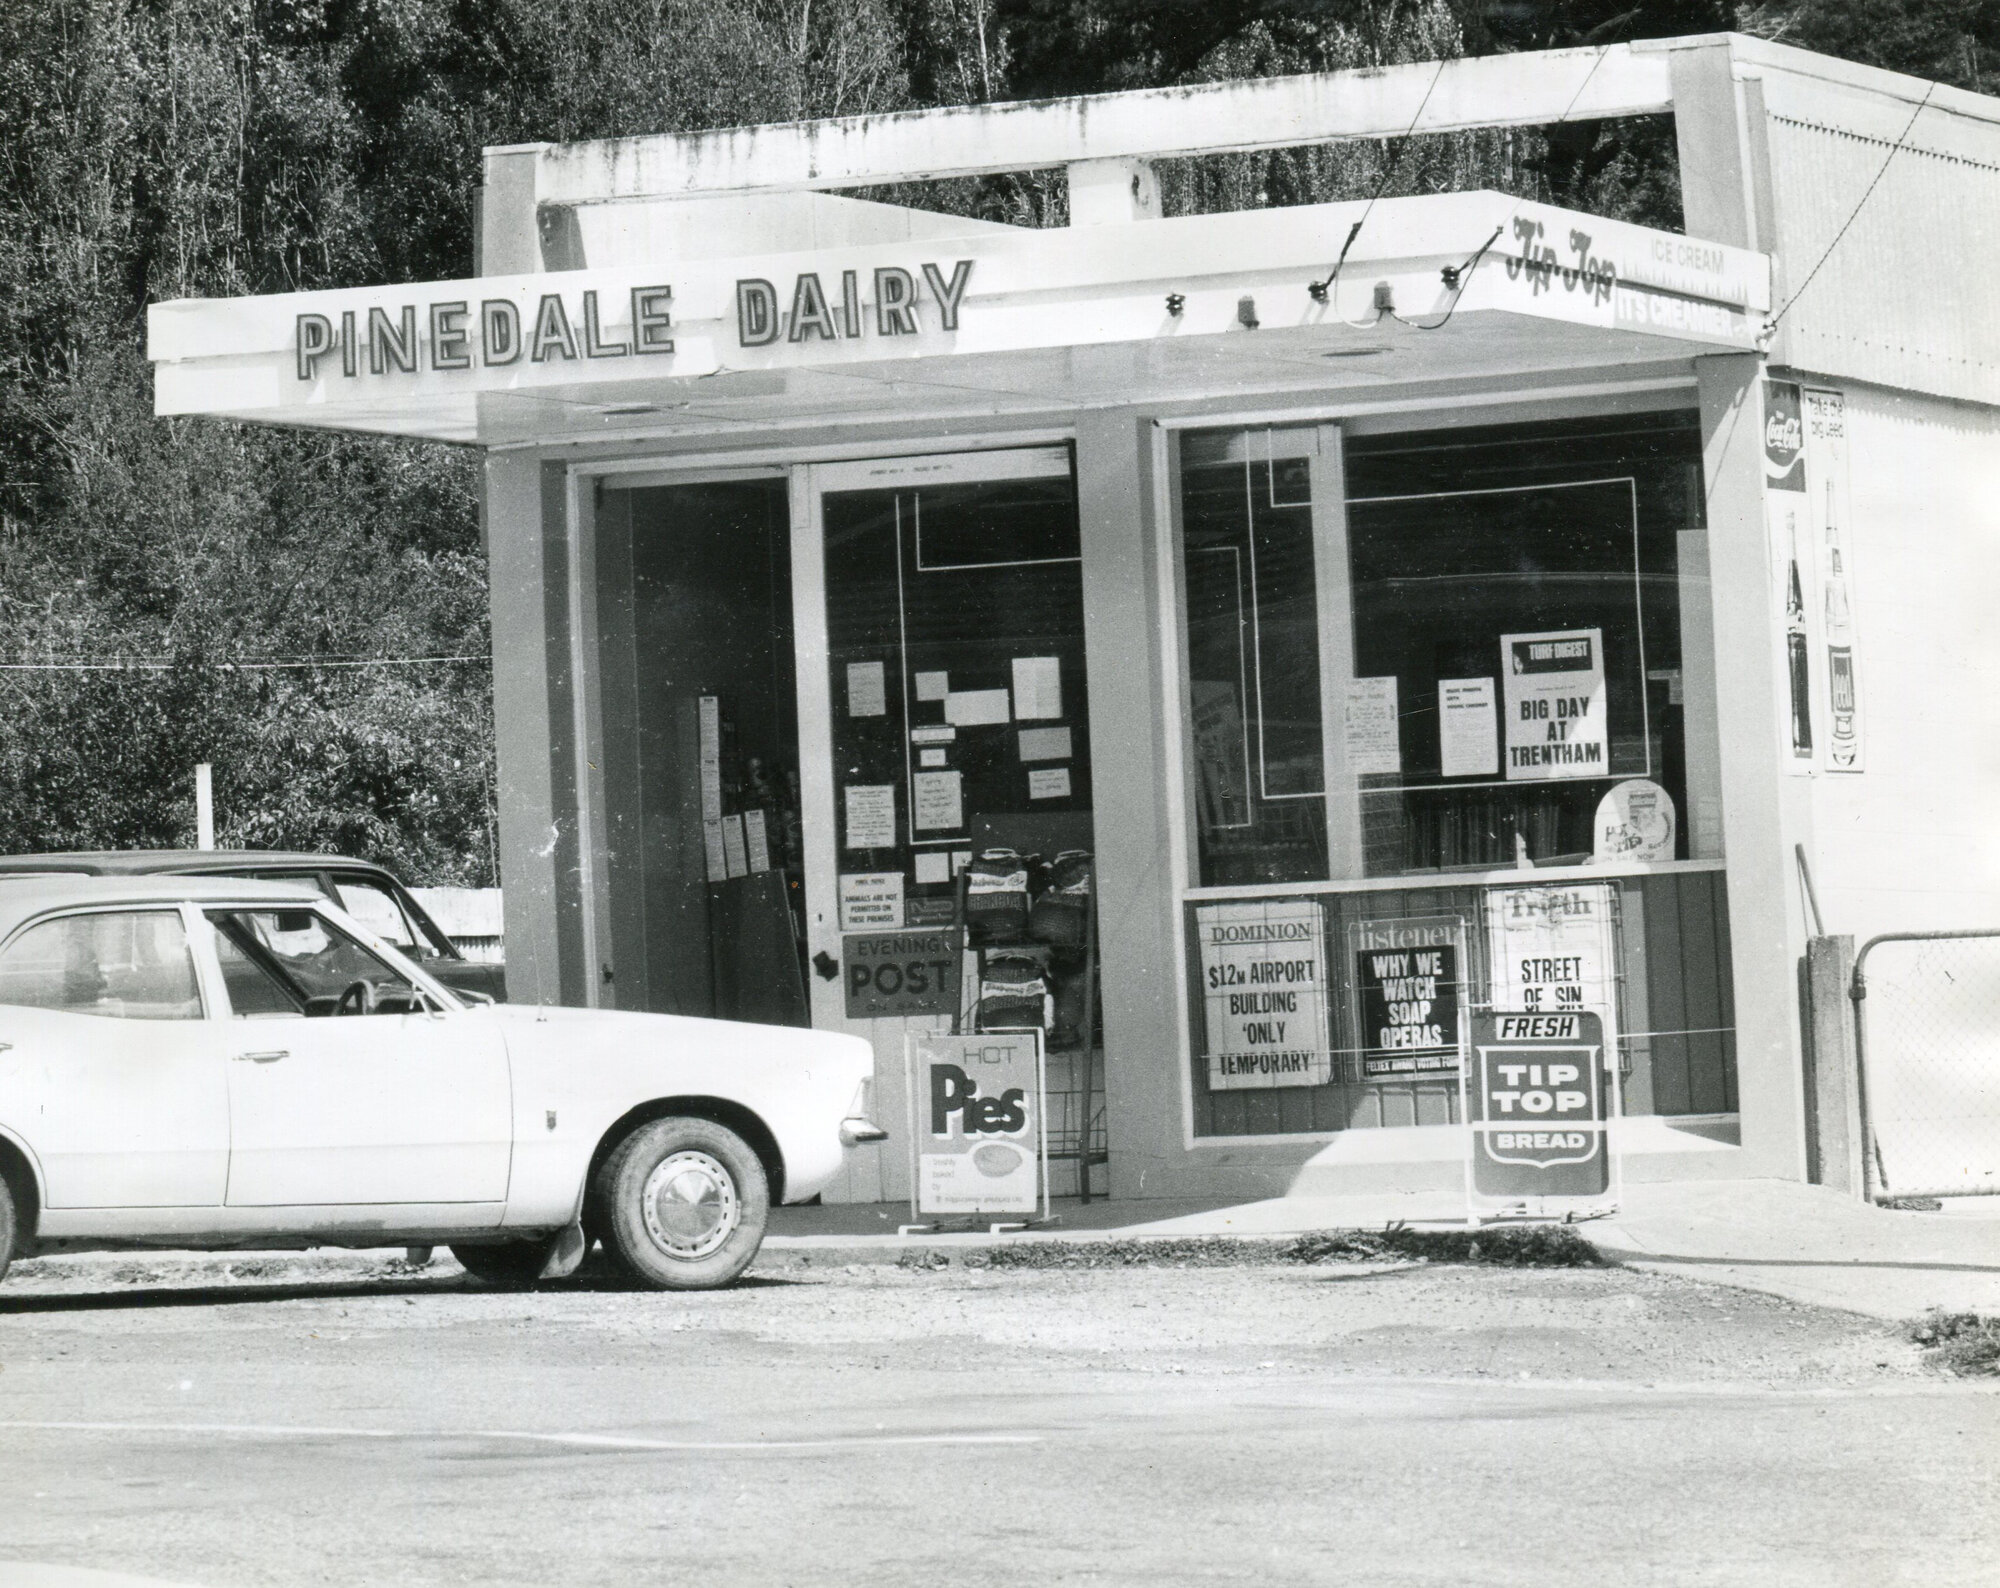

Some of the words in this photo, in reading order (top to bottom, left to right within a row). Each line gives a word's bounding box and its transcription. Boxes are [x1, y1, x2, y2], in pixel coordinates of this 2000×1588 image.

[1505, 215, 1560, 297] Tip
[1562, 228, 1617, 308] Top
[1651, 238, 1674, 264] ICE
[1676, 243, 1725, 276] CREAM
[293, 284, 676, 381] PINEDALE
[735, 258, 976, 349] DAIRY
[1520, 699, 1549, 721] BIG
[1556, 696, 1591, 719] DAY
[1546, 721, 1567, 742] AT
[1510, 742, 1602, 767] TRENTHAM
[1211, 922, 1312, 943] DOMINION
[857, 937, 940, 956] EVENING
[1250, 959, 1315, 984] AIRPORT
[1371, 954, 1410, 979] WHY
[1415, 951, 1443, 976] WE
[1520, 956, 1582, 984] STREET
[850, 960, 953, 996] POST
[1381, 976, 1437, 1002] WATCH
[1229, 991, 1297, 1016] BUILDING
[1523, 987, 1545, 1012] OF
[1555, 985, 1585, 1011] SIN
[1387, 1001, 1432, 1026] SOAP
[1379, 1024, 1443, 1048] OPERAS
[1501, 1016, 1575, 1038] FRESH
[963, 1045, 1018, 1065] HOT
[1497, 1064, 1580, 1086] TIP
[930, 1063, 1027, 1136] Pies
[1491, 1090, 1588, 1114] TOP
[1496, 1133, 1587, 1149] BREAD
